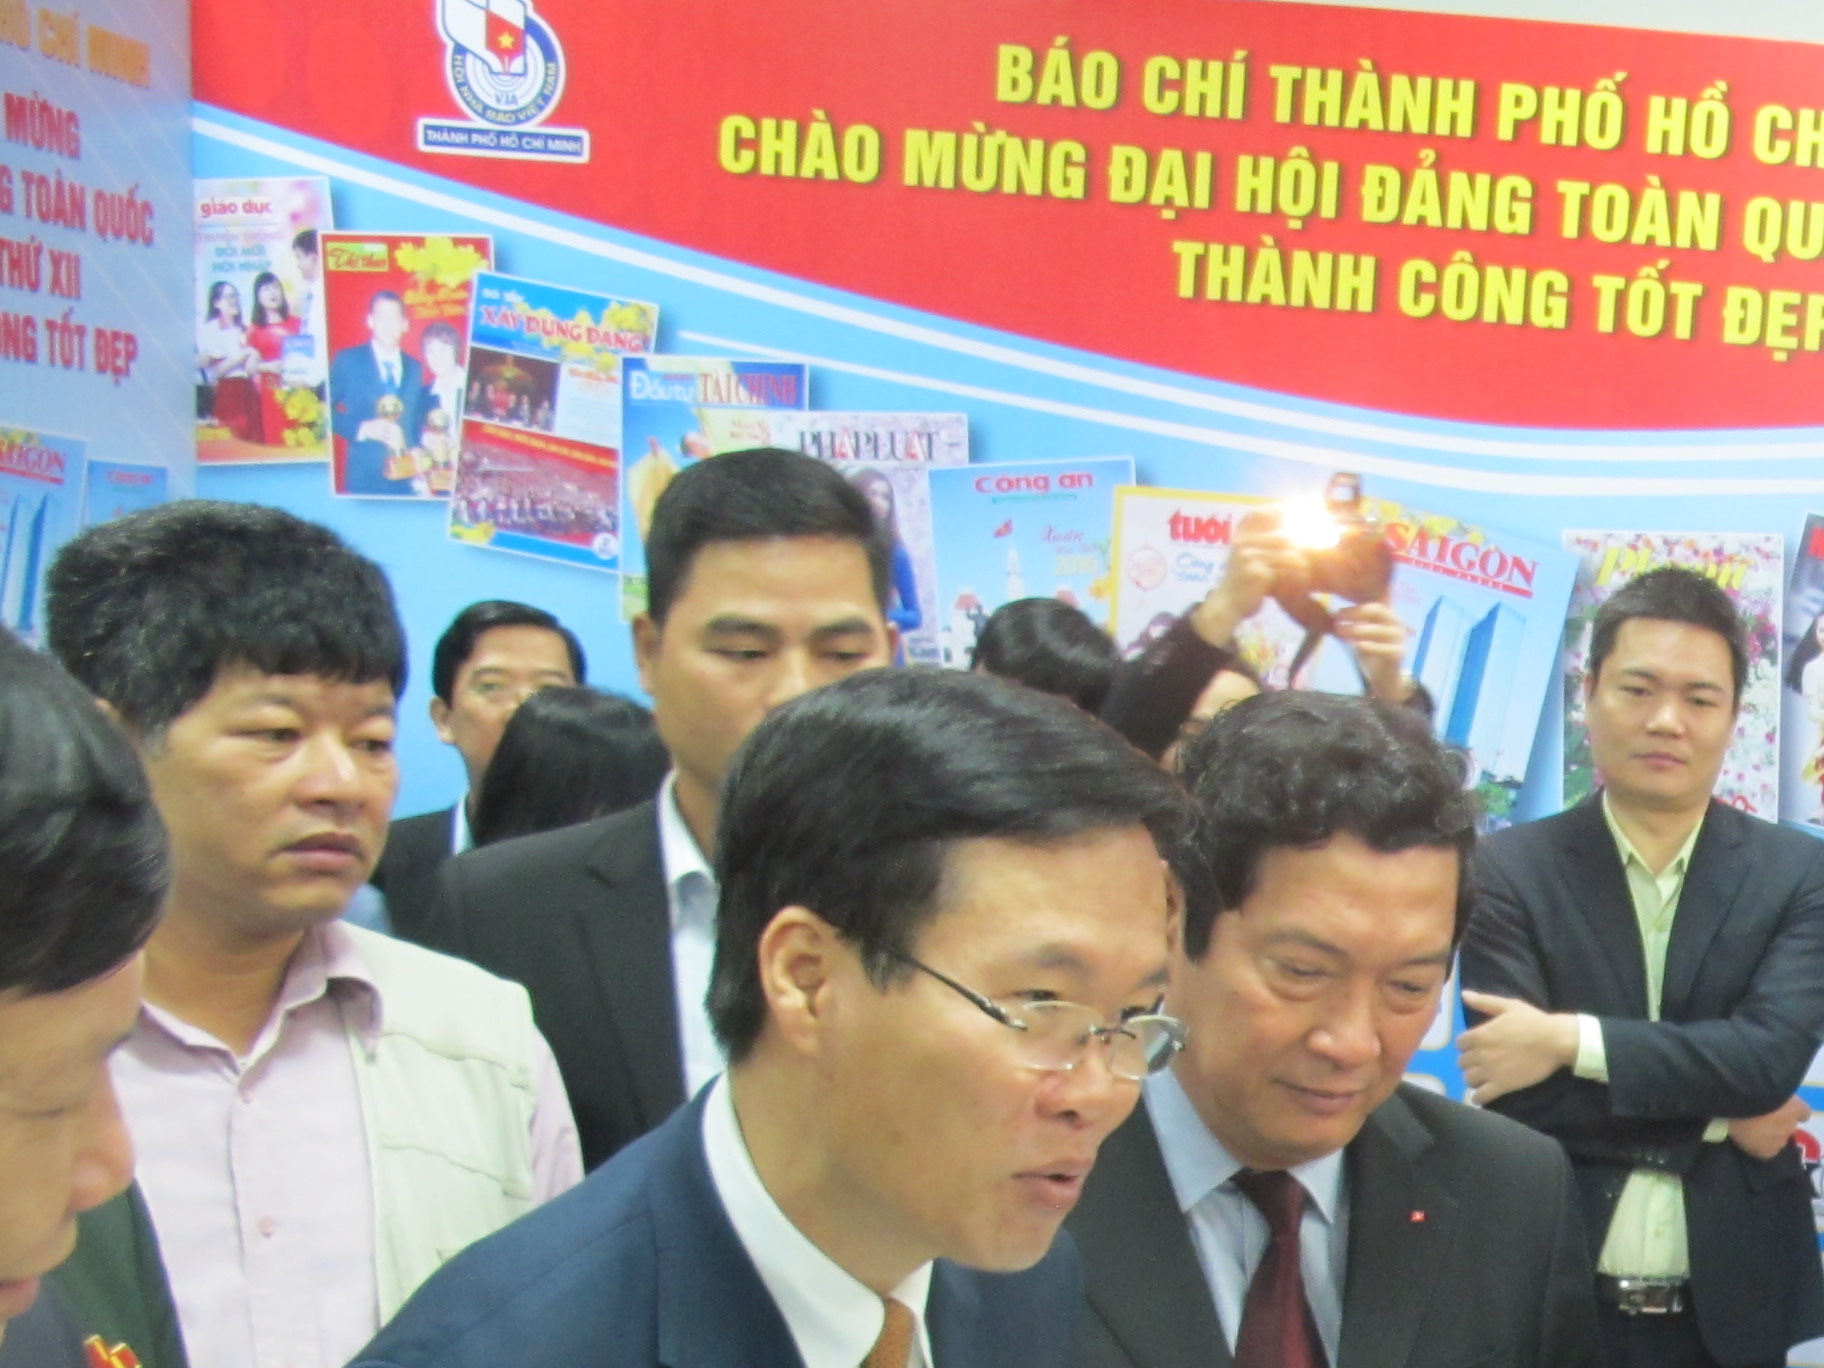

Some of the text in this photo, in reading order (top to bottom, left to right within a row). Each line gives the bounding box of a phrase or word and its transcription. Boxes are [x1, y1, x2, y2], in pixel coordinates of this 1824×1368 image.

[426, 128, 469, 143] THÀNH
[548, 139, 581, 153] MINH
[997, 36, 1119, 108] BÁO
[1144, 50, 1247, 119] CHÍ
[1270, 58, 1474, 138] THÀNH
[1498, 71, 1631, 150] PHỐ
[1647, 80, 1731, 159] HỒ
[719, 109, 881, 183] CHÀO
[904, 122, 1087, 199] MỪNG
[1108, 143, 1213, 219] ĐẠI
[1235, 145, 1340, 229] HỘI
[1362, 148, 1534, 235] ĐẢNG
[1558, 172, 1721, 250] TOÀN
[1173, 236, 1376, 313] THÀNH
[1399, 253, 1569, 330] CÔNG
[1592, 259, 1702, 341] TỐT
[1058, 472, 1093, 488] an
